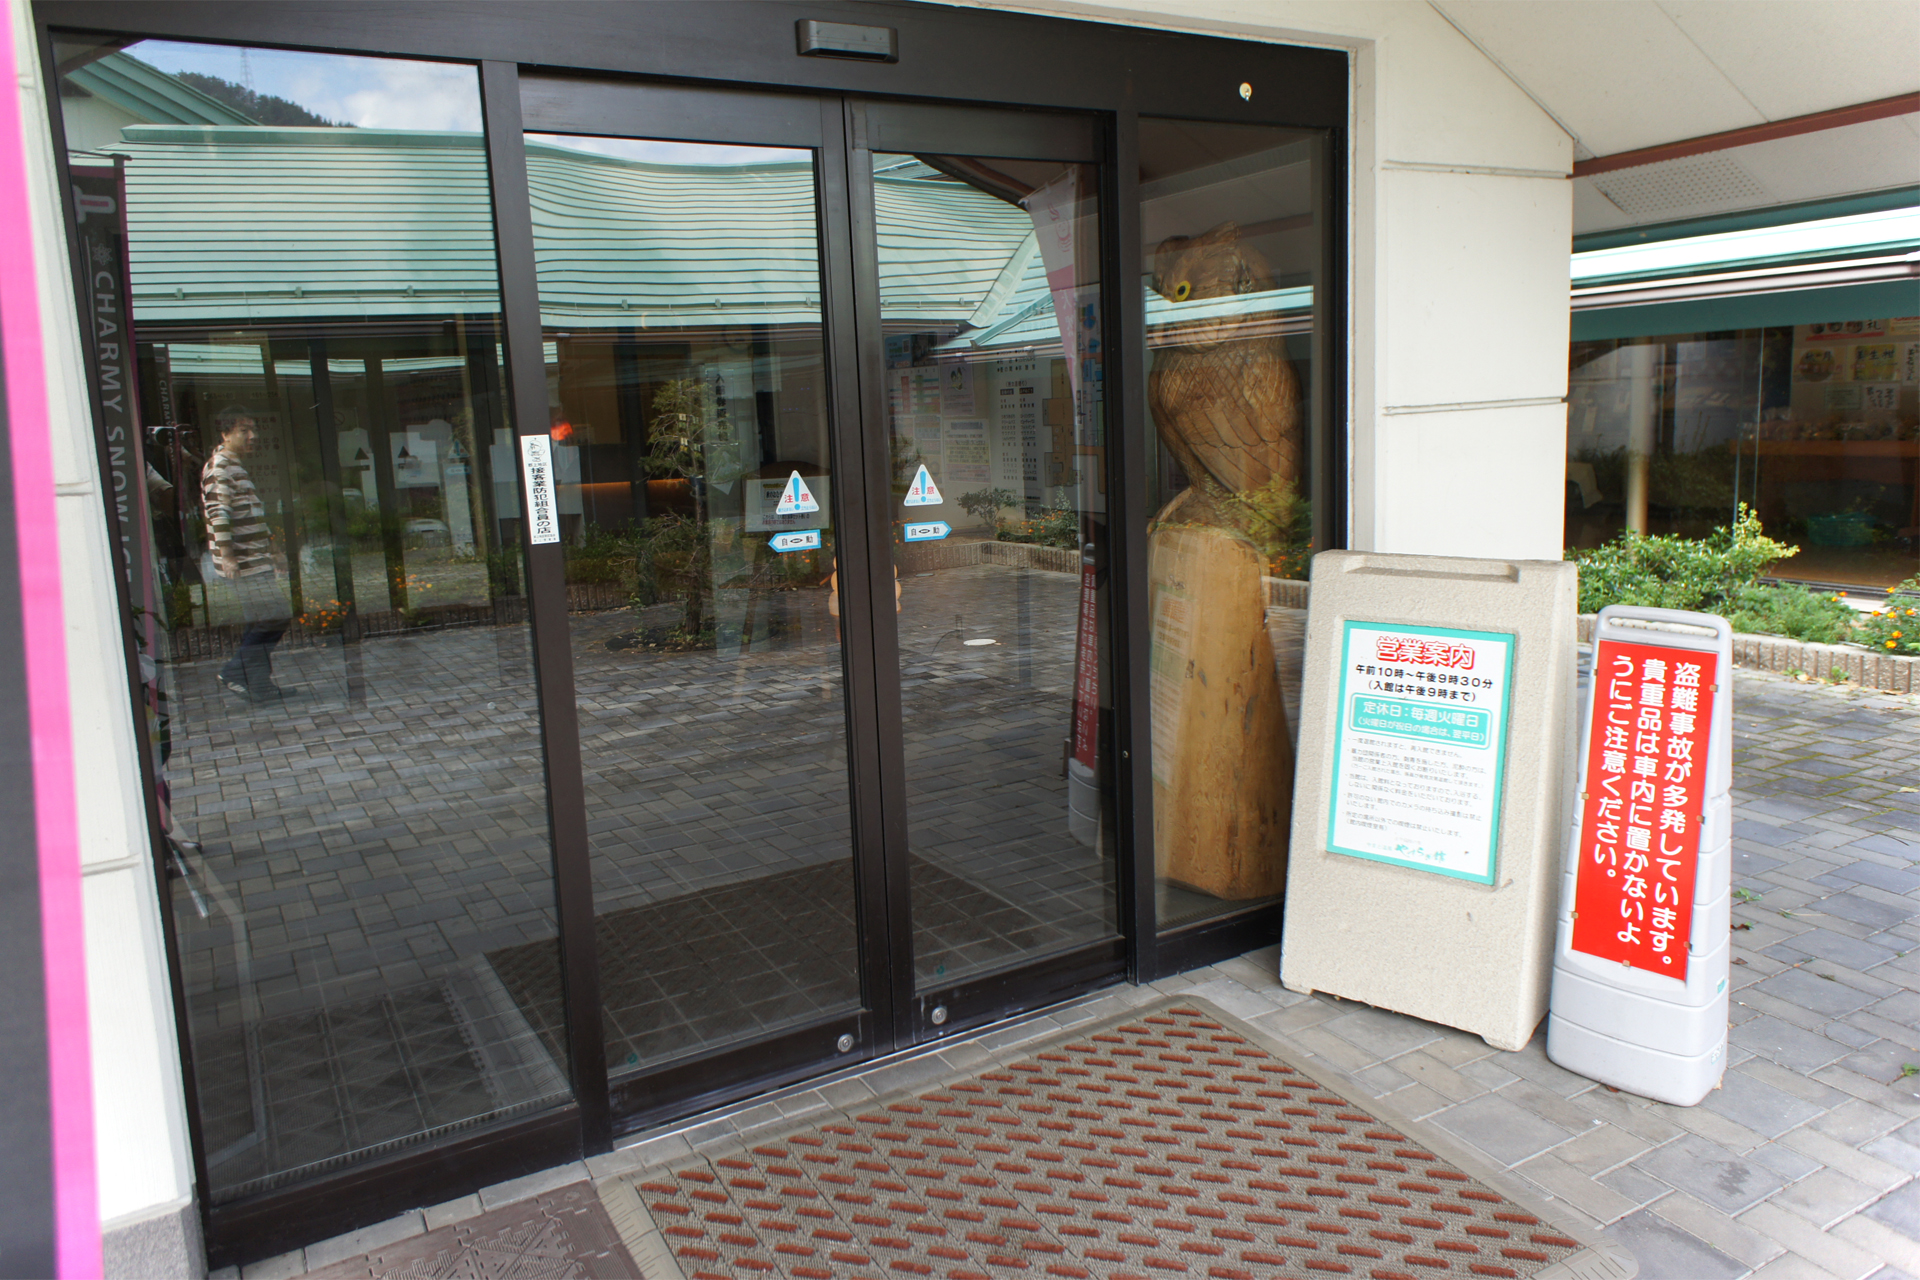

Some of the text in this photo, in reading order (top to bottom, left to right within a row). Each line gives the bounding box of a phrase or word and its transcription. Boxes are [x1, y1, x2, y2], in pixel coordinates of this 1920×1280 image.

[96, 271, 122, 413] CHARMY
[531, 467, 551, 534] 接客業防犯組合員の店
[1375, 635, 1476, 670] 営業案内
[1594, 654, 1635, 878] うにご注意ください。
[1616, 657, 1668, 946] 貴重品は車内に置かないよ
[1649, 661, 1702, 966] 盗難事故が多発しています。
